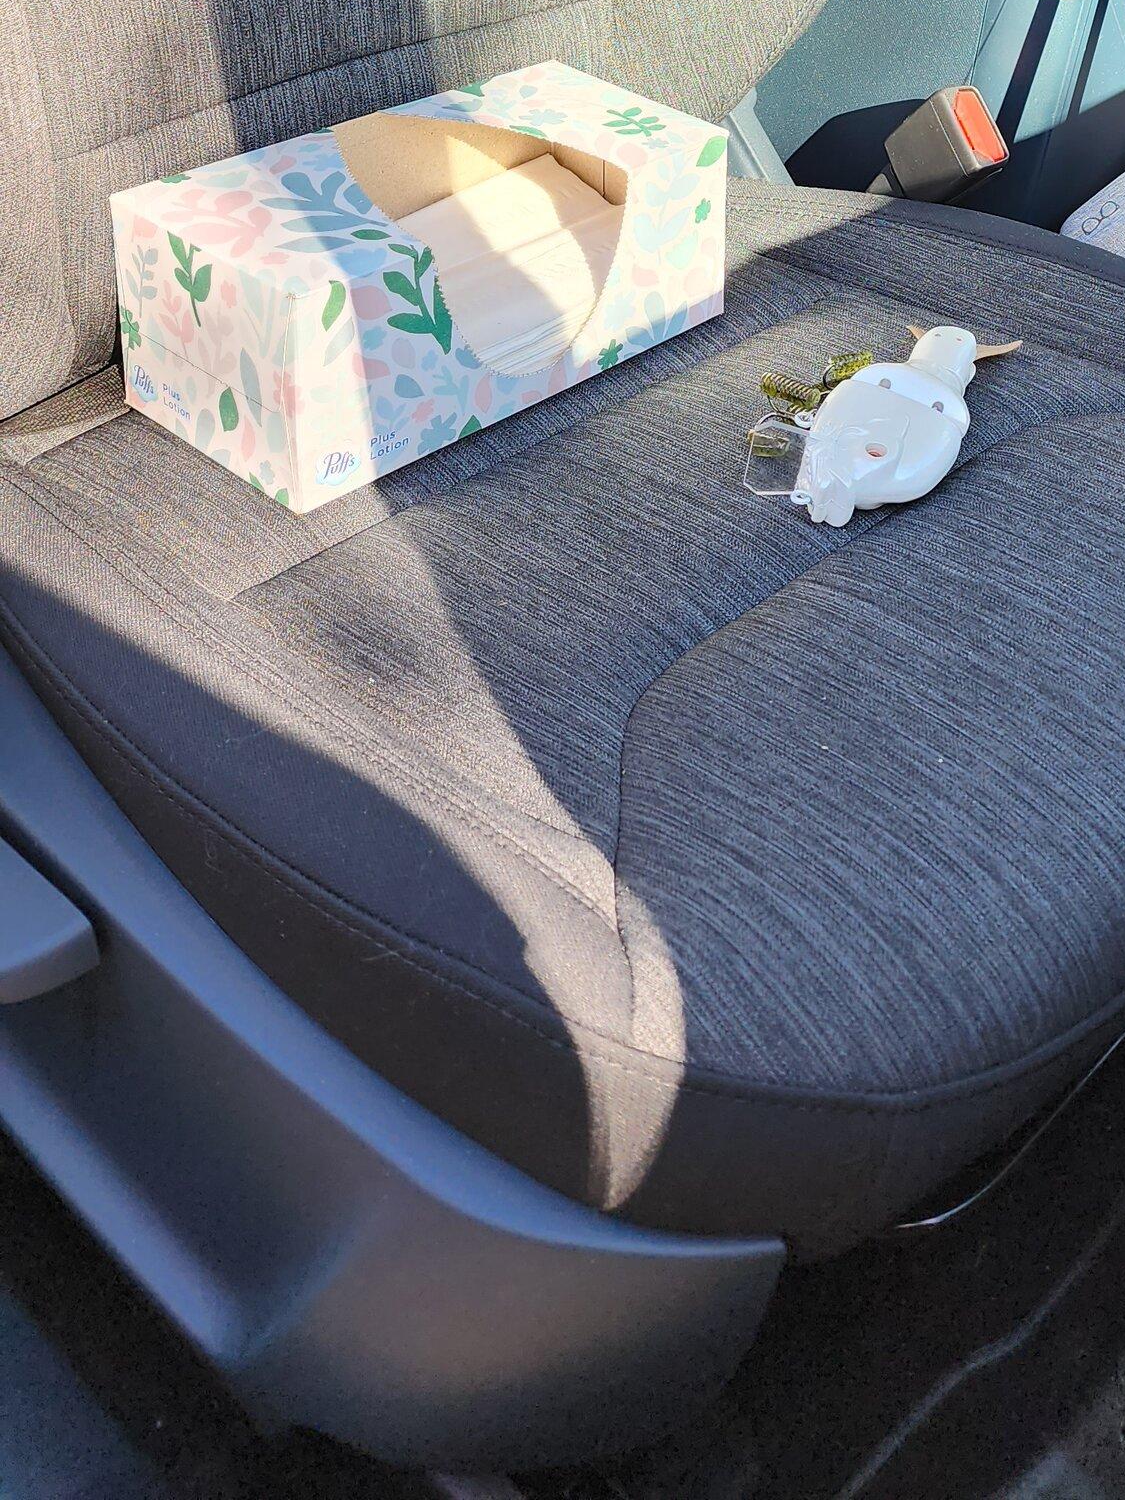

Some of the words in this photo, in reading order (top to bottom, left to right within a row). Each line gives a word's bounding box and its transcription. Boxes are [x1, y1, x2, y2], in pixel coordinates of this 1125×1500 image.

[133, 364, 154, 394] Puffs
[162, 383, 181, 401] Plus
[163, 396, 191, 421] Lotion
[370, 430, 396, 448] Plus
[370, 437, 409, 460] Lotion
[323, 451, 355, 480] Puffs
